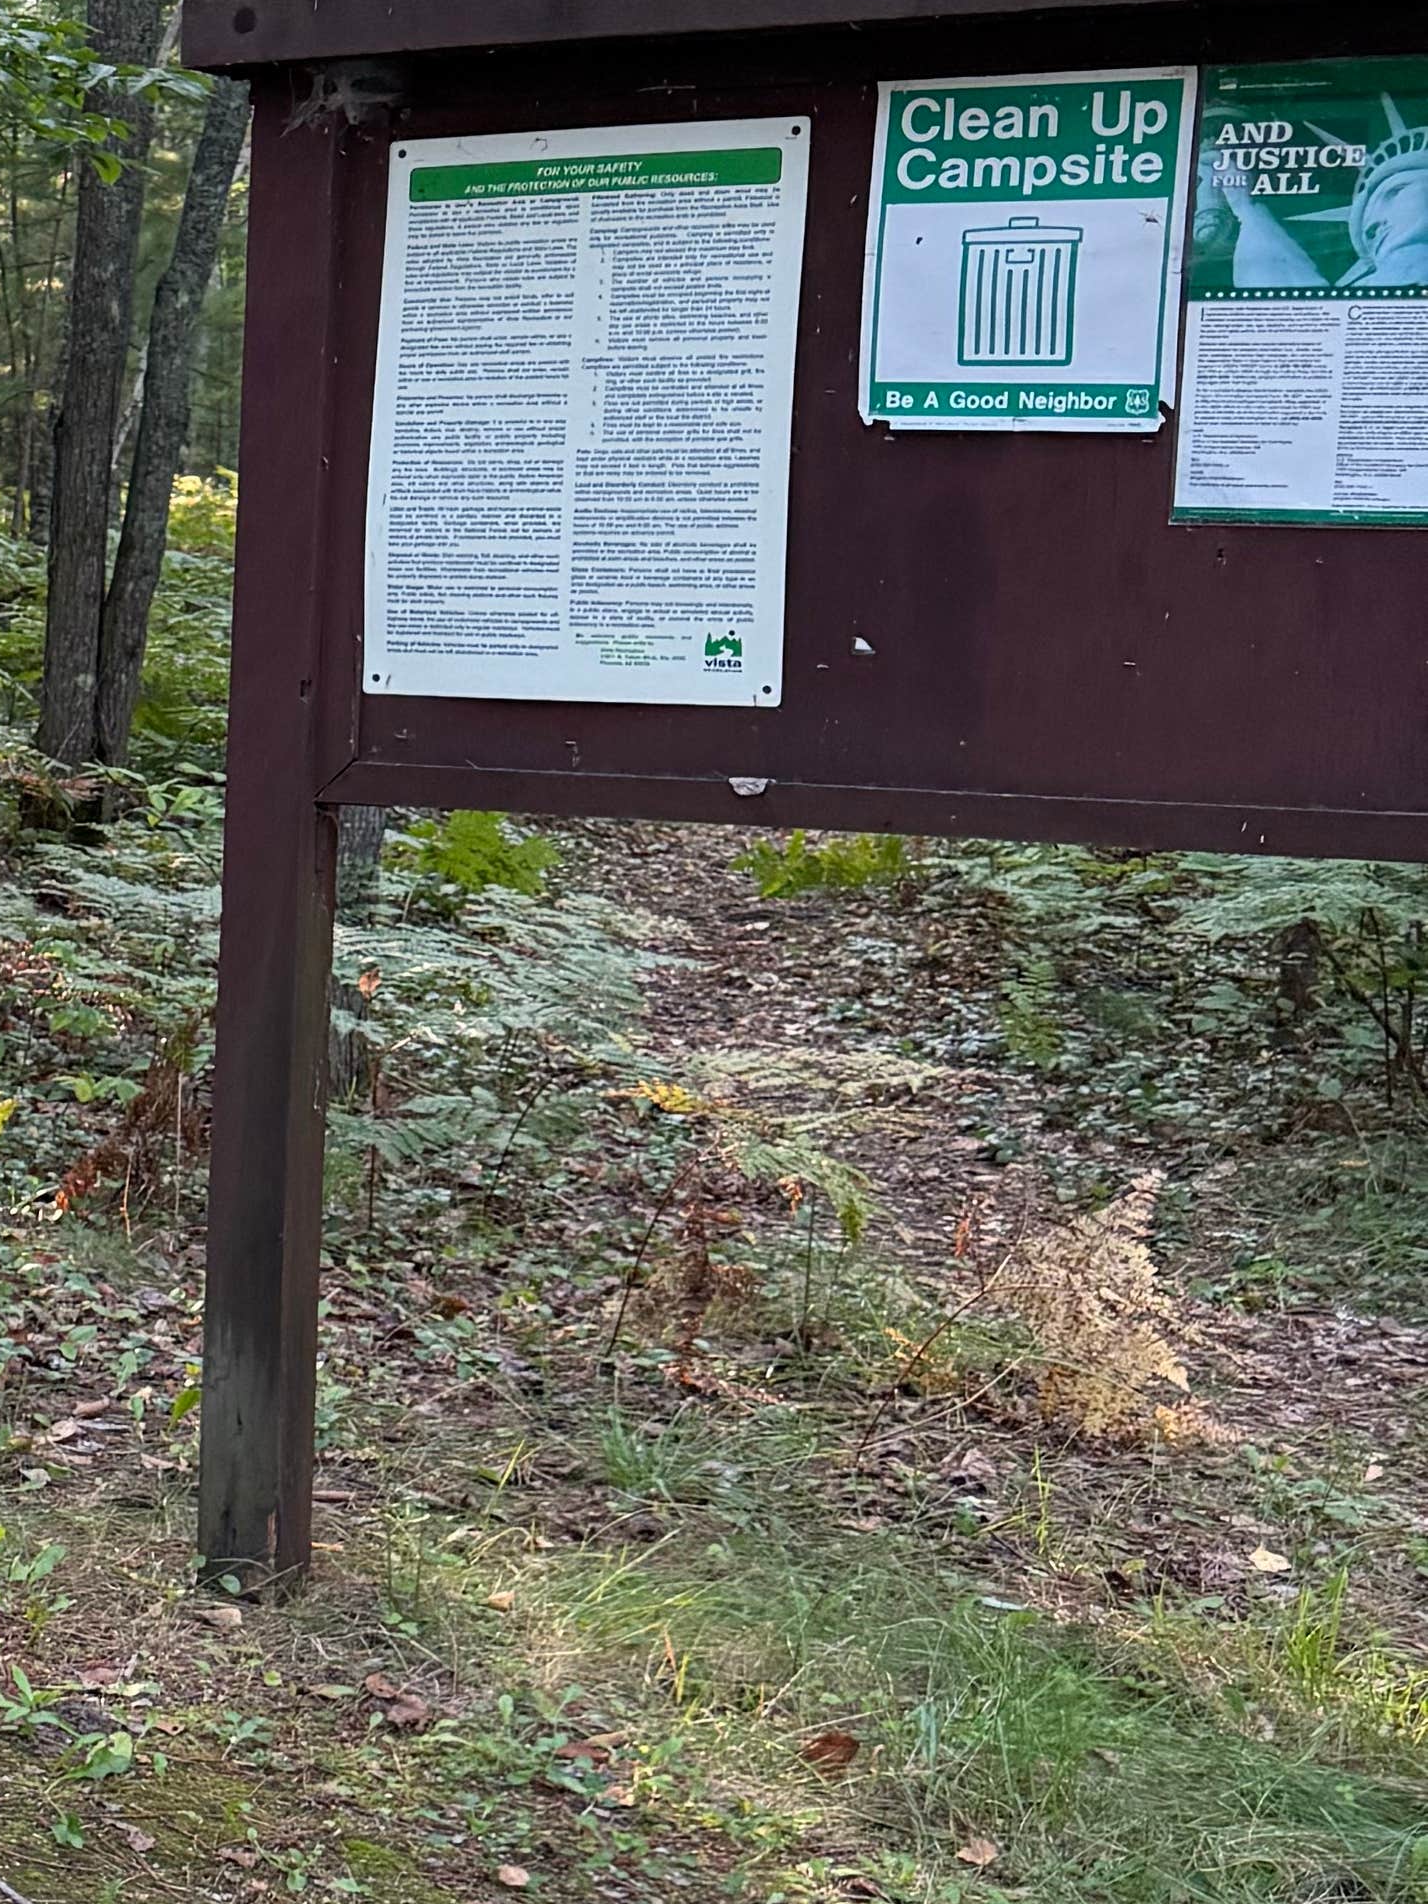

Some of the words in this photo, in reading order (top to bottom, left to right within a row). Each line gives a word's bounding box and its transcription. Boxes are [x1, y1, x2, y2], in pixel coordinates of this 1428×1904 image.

[901, 97, 1059, 143] Clean
[1091, 90, 1168, 144] Up
[1215, 121, 1294, 145] AND
[536, 166, 561, 177] FOR
[562, 163, 594, 176] YOUR
[596, 161, 643, 174] SAFETY
[896, 144, 1164, 195] Campsite
[1212, 145, 1366, 171] JUSTICE
[464, 183, 486, 195] AND
[486, 182, 506, 194] THE
[507, 179, 571, 193] PROTECTION
[571, 178, 586, 190] OF
[588, 177, 611, 189] OUR
[611, 175, 648, 188] PUBLIC
[1212, 175, 1247, 188] FOR
[1250, 172, 1320, 196] ALL
[886, 391, 914, 409] Be
[924, 391, 939, 409] A
[949, 390, 1008, 410] Good
[1018, 391, 1117, 413] Neighbor
[704, 658, 742, 669] vista
